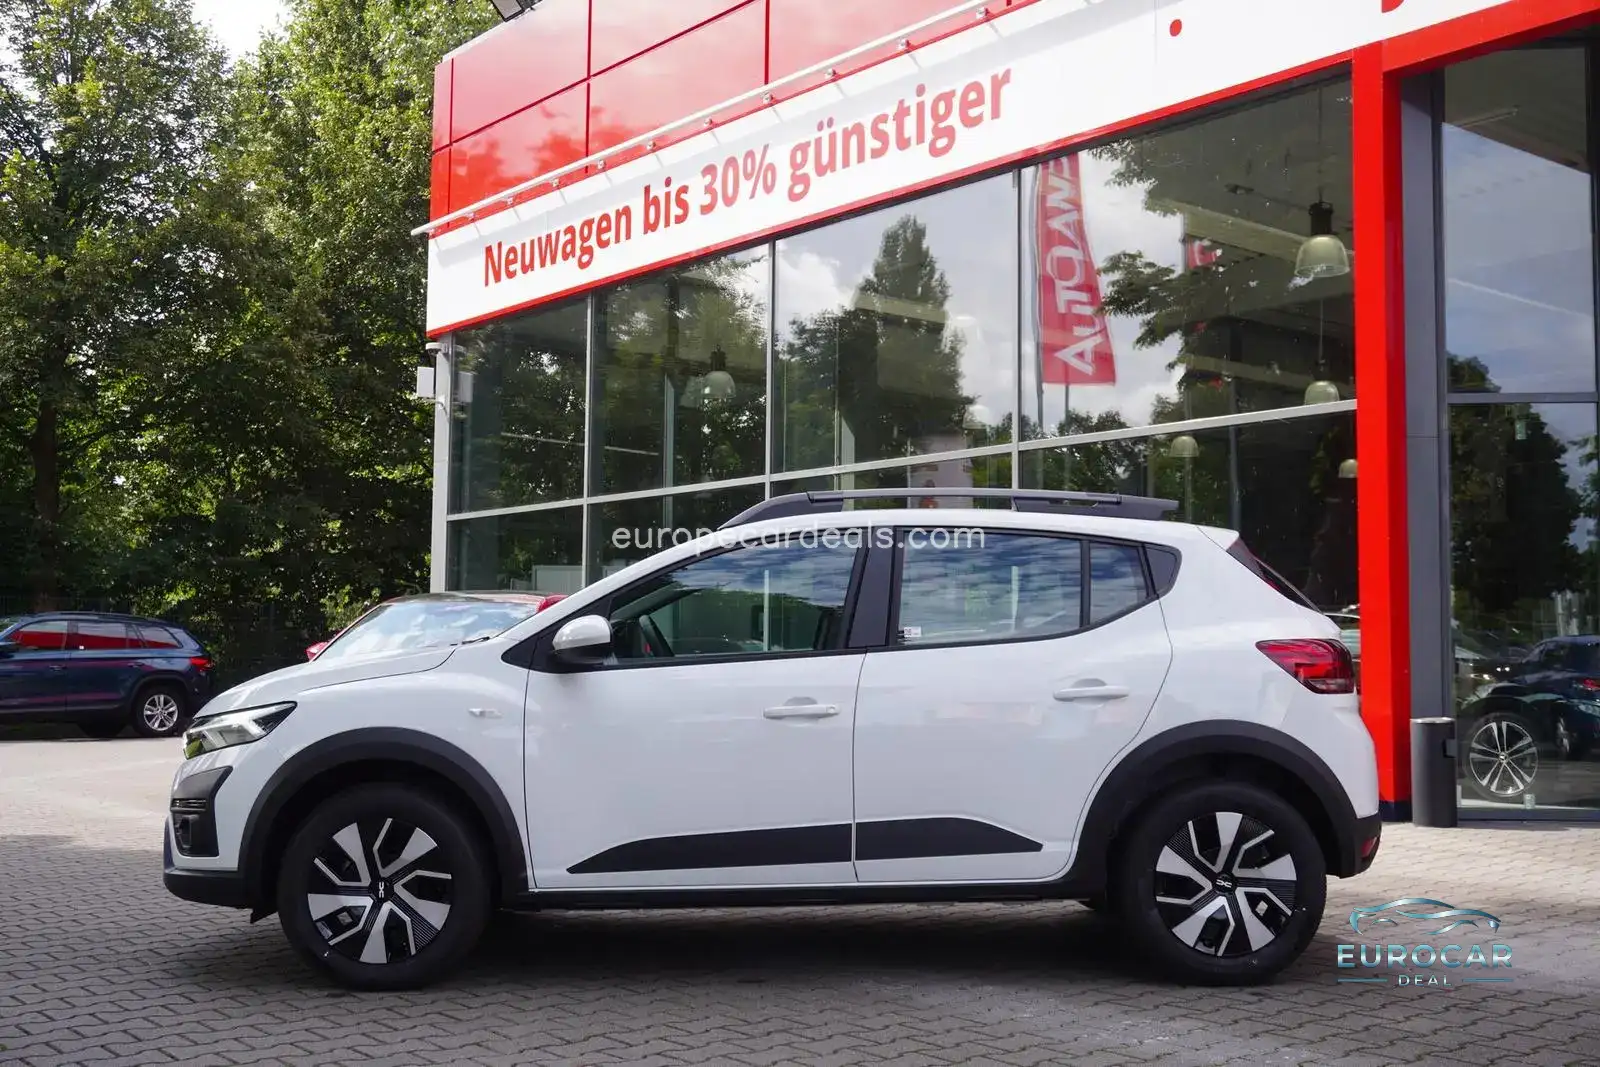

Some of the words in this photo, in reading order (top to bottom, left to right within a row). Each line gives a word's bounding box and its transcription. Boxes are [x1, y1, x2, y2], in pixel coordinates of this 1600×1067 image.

[484, 206, 632, 287] Neuwagen
[643, 176, 690, 235] bis
[699, 144, 777, 215] 30%
[787, 70, 1010, 202] günstiger
